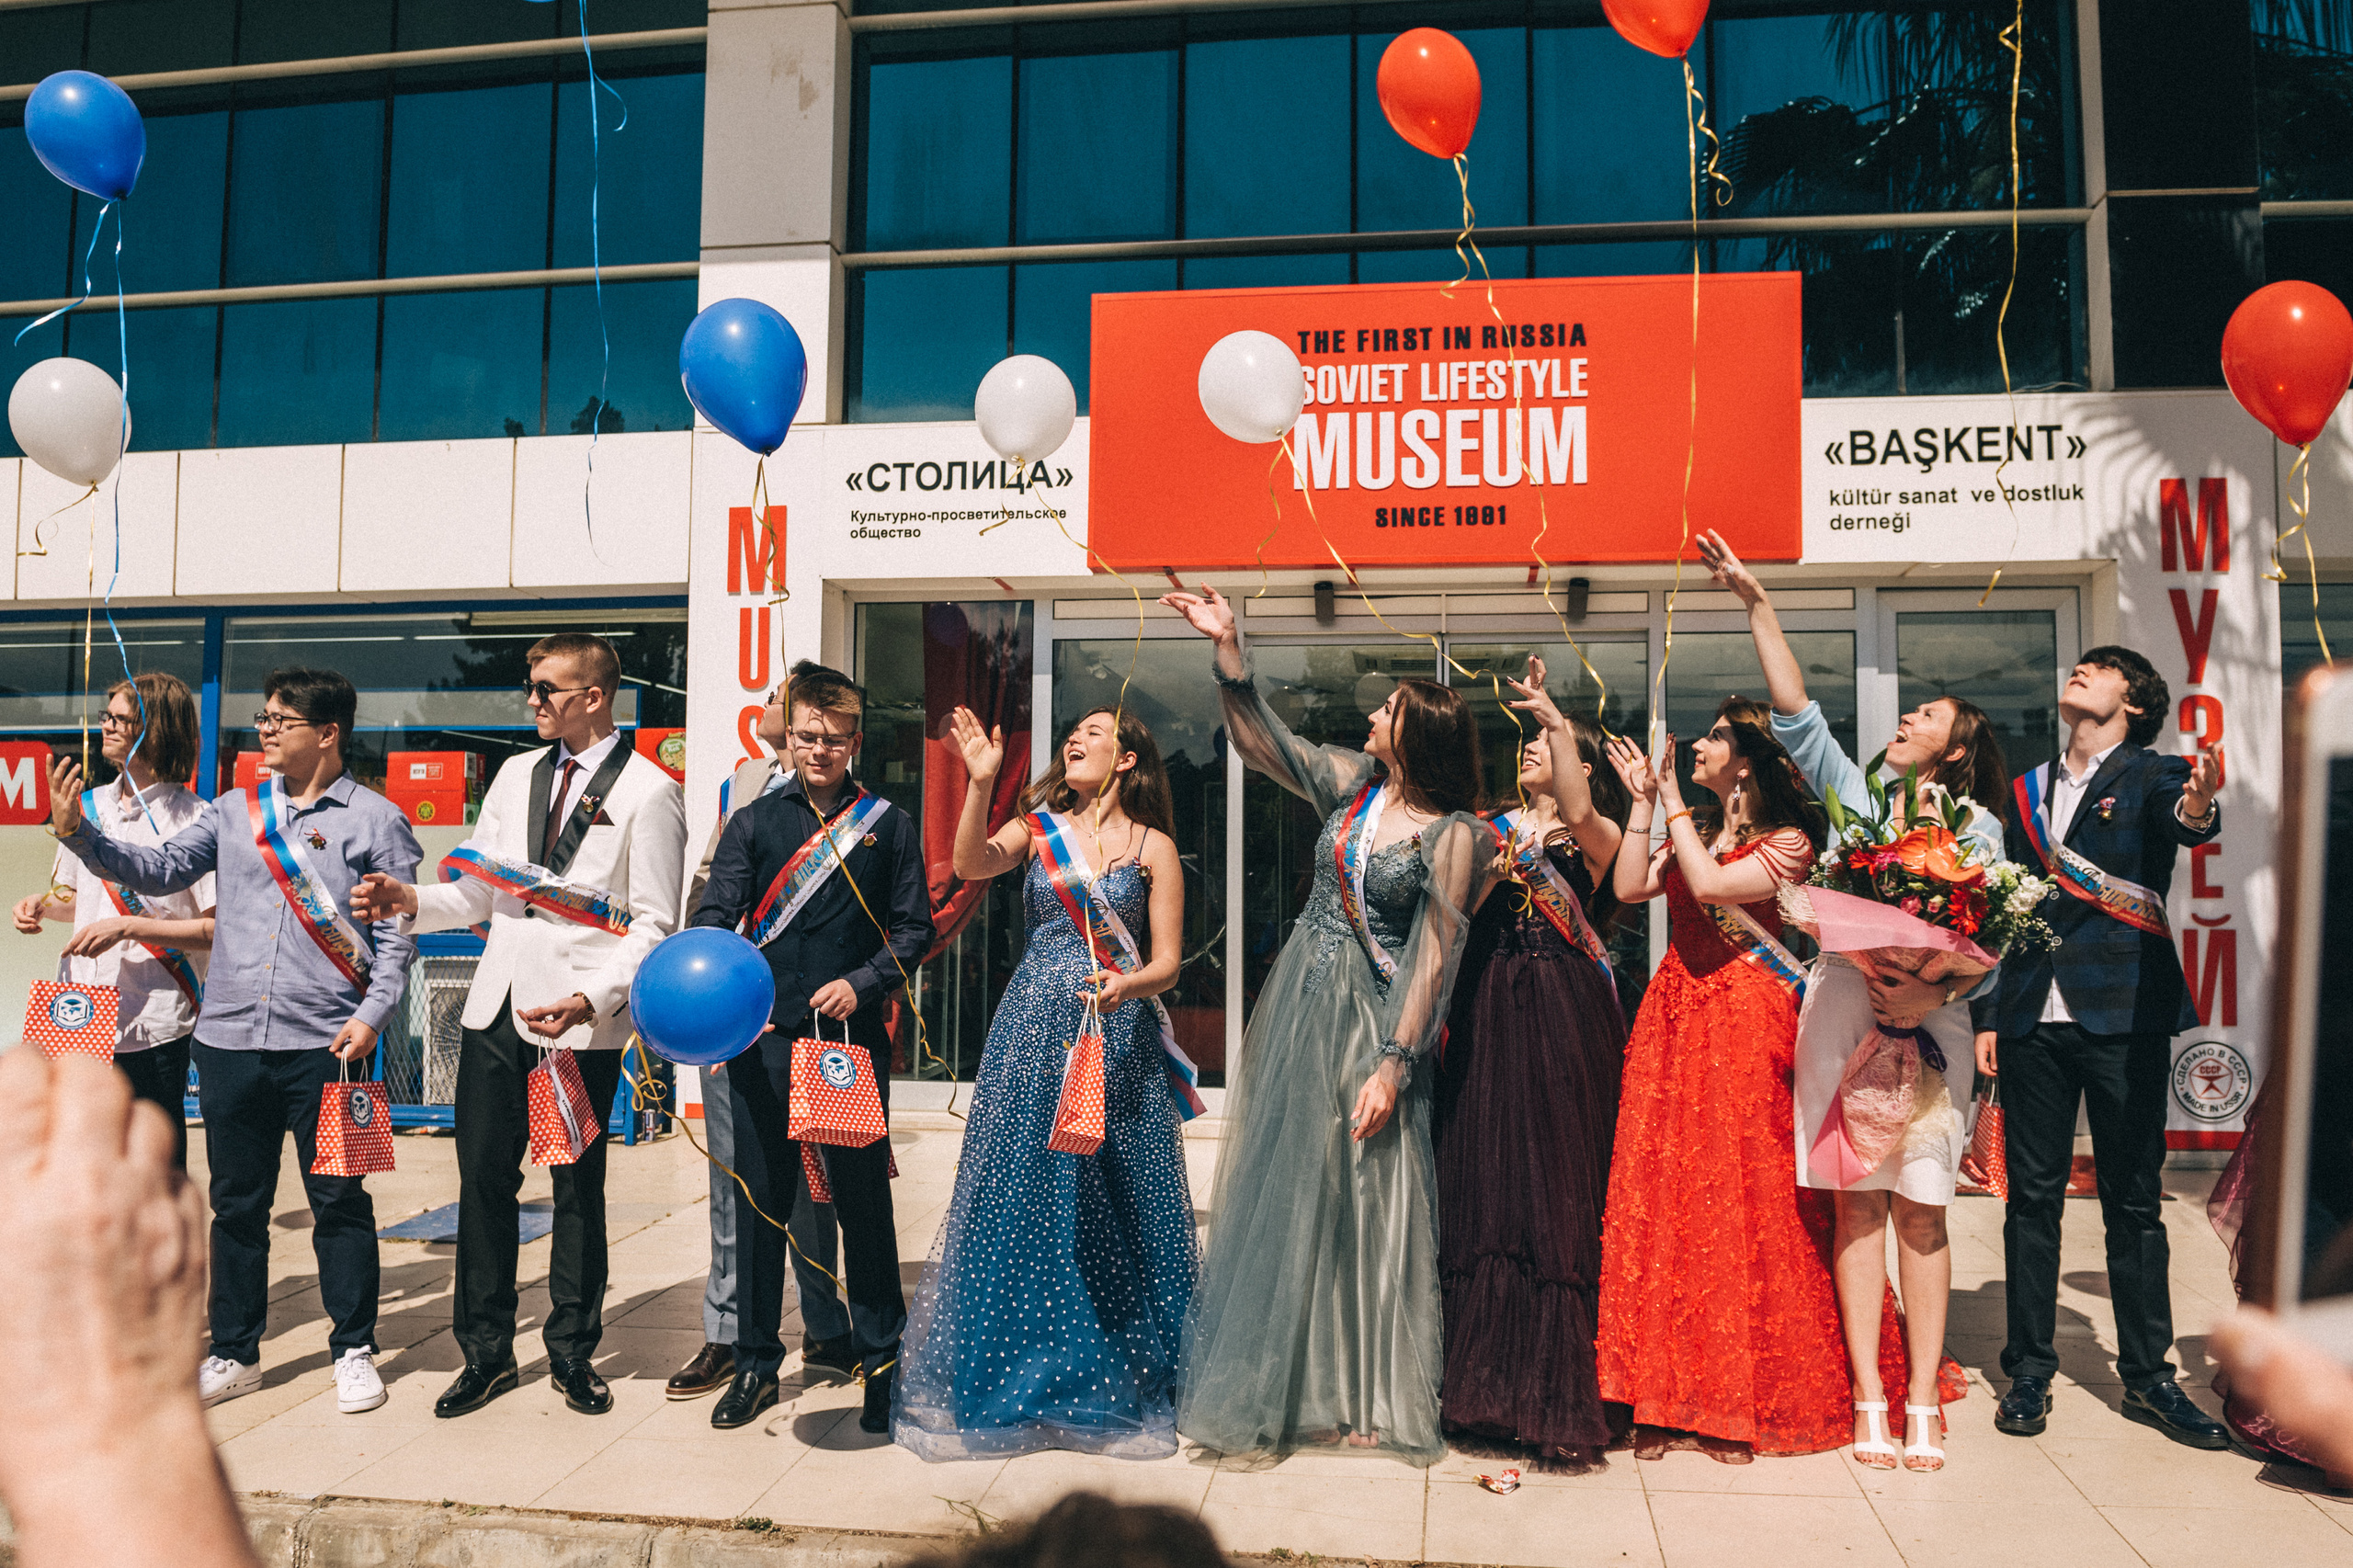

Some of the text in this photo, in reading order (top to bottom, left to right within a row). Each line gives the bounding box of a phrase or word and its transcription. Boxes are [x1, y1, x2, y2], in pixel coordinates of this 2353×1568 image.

[1297, 323, 1587, 355] THE FIRST IN RUSSIA
[1302, 358, 1588, 405] SOVIET LIFESTYLE
[1292, 405, 1588, 492] MUSEUM
[1824, 424, 2087, 474] «BAŞKENT»
[845, 459, 1074, 495] «СТОЛИЦА»
[1829, 483, 2085, 506] kültür sanat ve dostluk
[850, 508, 1067, 526] Культурно-просветительское
[1375, 506, 1446, 528] SINCE
[1829, 511, 1911, 533] derneği
[849, 526, 922, 540] общество
[2177, 1048, 2247, 1085] СДЕЛАНО В СССР
[2182, 1091, 2207, 1112] MADE
[2220, 1091, 2244, 1111] USSR
